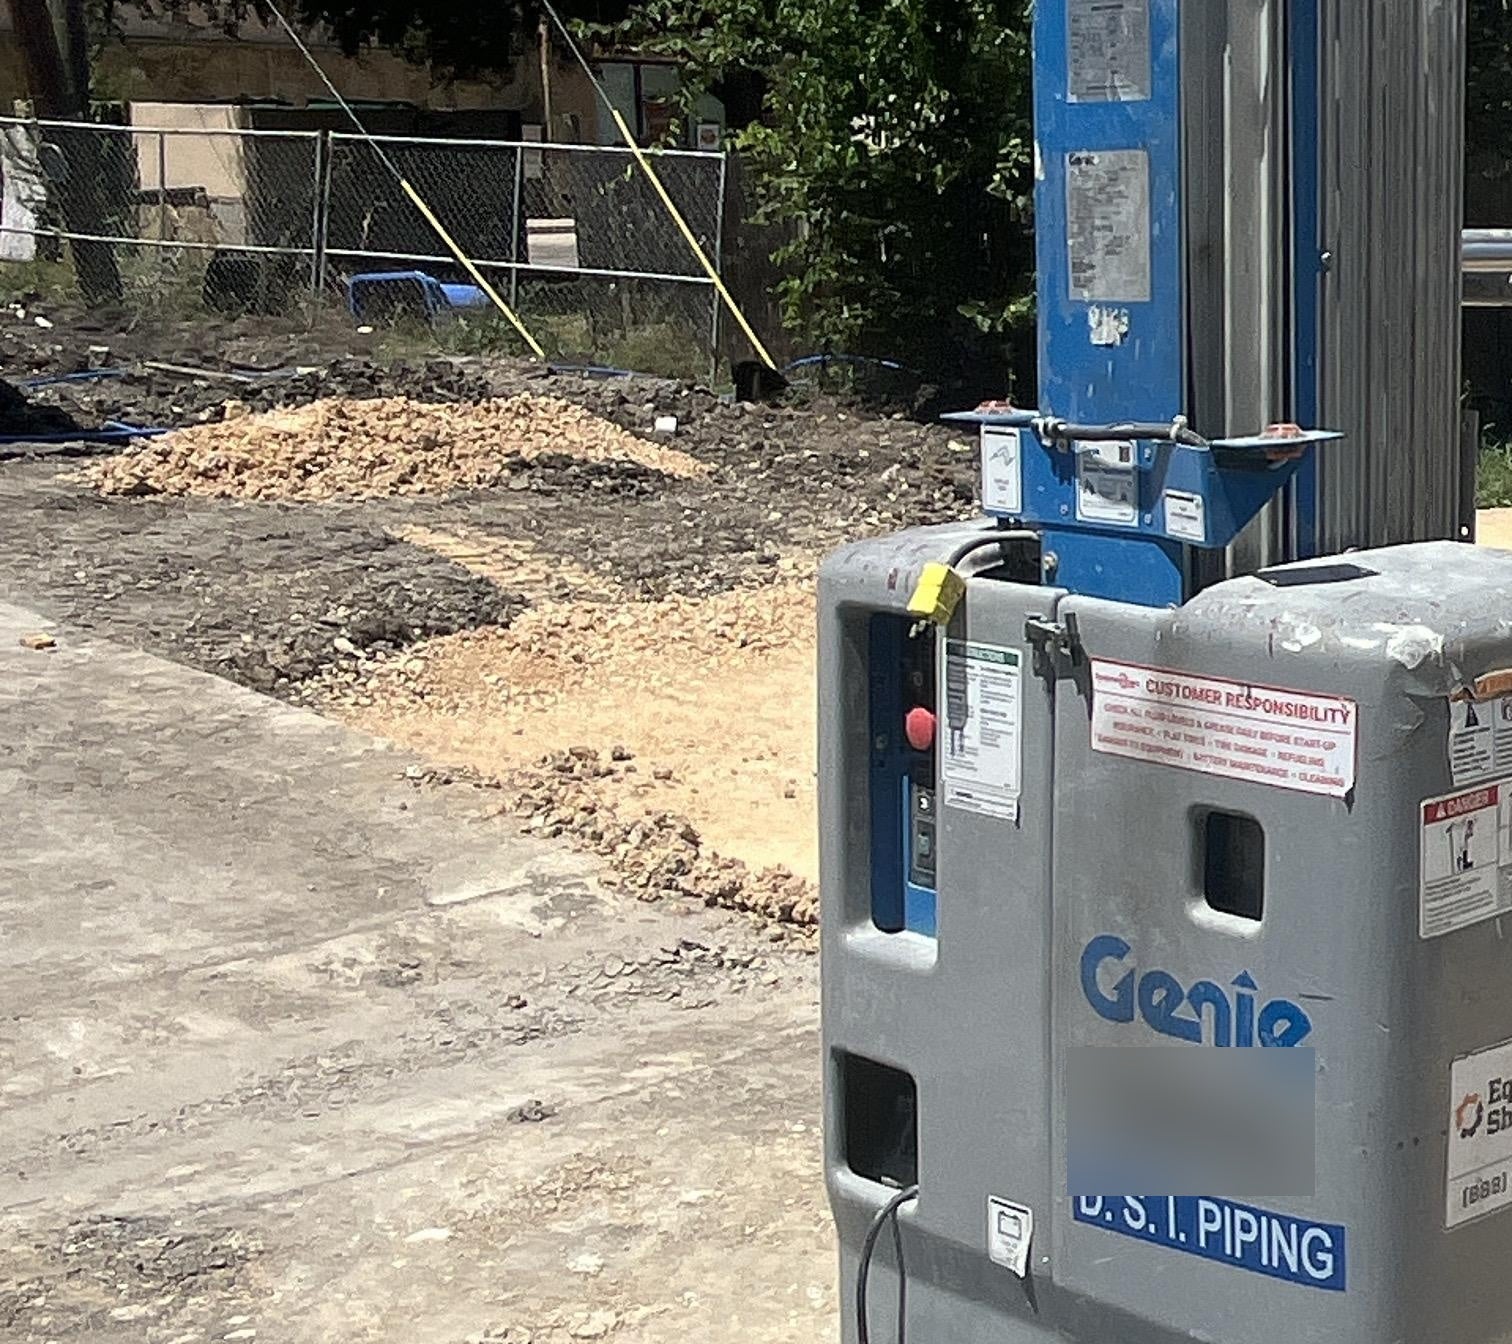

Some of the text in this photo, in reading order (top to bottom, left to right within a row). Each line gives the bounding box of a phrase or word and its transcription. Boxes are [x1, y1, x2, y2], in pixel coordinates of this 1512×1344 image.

[1145, 678, 1222, 706] CUSTOMER
[1225, 691, 1350, 725] RESPONSIBILITY
[1080, 934, 1312, 1048] Genie
[1123, 1196, 1156, 1234] S.
[1168, 1196, 1187, 1243] I.
[1198, 1198, 1334, 1280] PIPING
